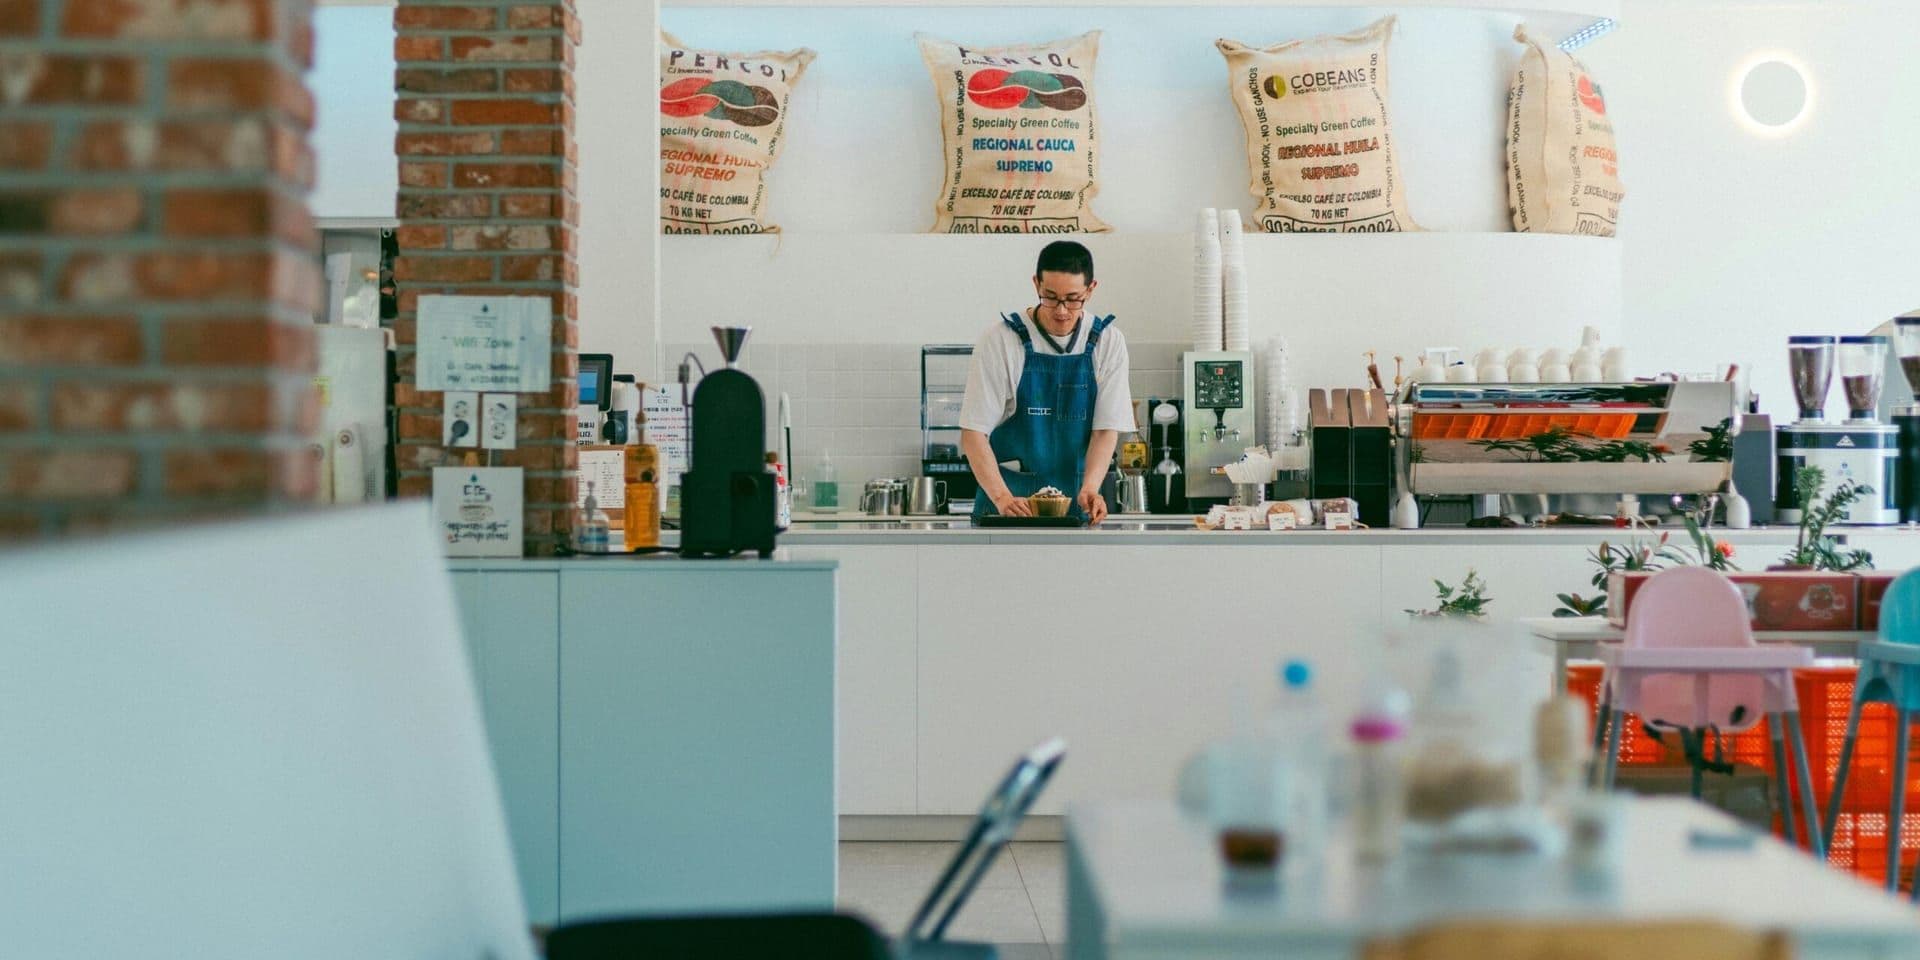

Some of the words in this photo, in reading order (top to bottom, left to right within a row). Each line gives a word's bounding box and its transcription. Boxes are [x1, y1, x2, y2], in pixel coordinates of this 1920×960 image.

[1370, 53, 1377, 66] DO
[1290, 68, 1366, 89] COBEANS
[1369, 67, 1377, 84] NOT
[954, 70, 965, 106] GANCHOS
[1248, 66, 1264, 106] GANCHOS
[956, 108, 965, 123] USE
[1255, 107, 1268, 123] USE
[956, 123, 964, 136] NO
[972, 117, 1017, 131] Specialty
[1019, 117, 1049, 129] Green
[1051, 118, 1080, 130] Coffee
[1261, 124, 1270, 138] NO
[1275, 124, 1318, 138] Specialty
[1320, 121, 1349, 132] Green
[1350, 116, 1376, 128] Coffee
[660, 126, 699, 137] pecialty
[701, 127, 731, 138] Green
[733, 129, 758, 146] Coffee
[972, 138, 1034, 151] REGIONAL
[1036, 138, 1076, 152] CAUCA
[1278, 142, 1342, 160] REGIONAL
[1343, 136, 1380, 155] HUILA
[660, 149, 720, 165] EGIONAL
[955, 146, 963, 169] HOOK
[1261, 143, 1271, 168] HOOK
[664, 162, 736, 182] SUPREMO
[996, 159, 1053, 173] SUPREMO
[1301, 162, 1360, 181] SUPREMO
[1514, 164, 1522, 181] USE
[954, 170, 962, 185] USE
[672, 189, 694, 202] CAFÉ
[696, 192, 708, 204] DE
[709, 194, 749, 206] COLOMBIA
[961, 187, 998, 198] EXCELSO
[999, 187, 1023, 200] CAFÉ
[1024, 189, 1036, 200] DE
[1313, 192, 1335, 204] CAFÉ
[1335, 192, 1346, 204] DE
[1347, 188, 1382, 202] COLOMBIA
[669, 205, 680, 217] 70
[682, 206, 694, 218] KG
[695, 208, 713, 219] NET
[991, 205, 1002, 215] 70
[1003, 205, 1016, 216] KG
[1017, 205, 1036, 216] NET
[1311, 208, 1320, 219] 70
[1321, 208, 1333, 219] KG
[1334, 207, 1350, 218] NET
